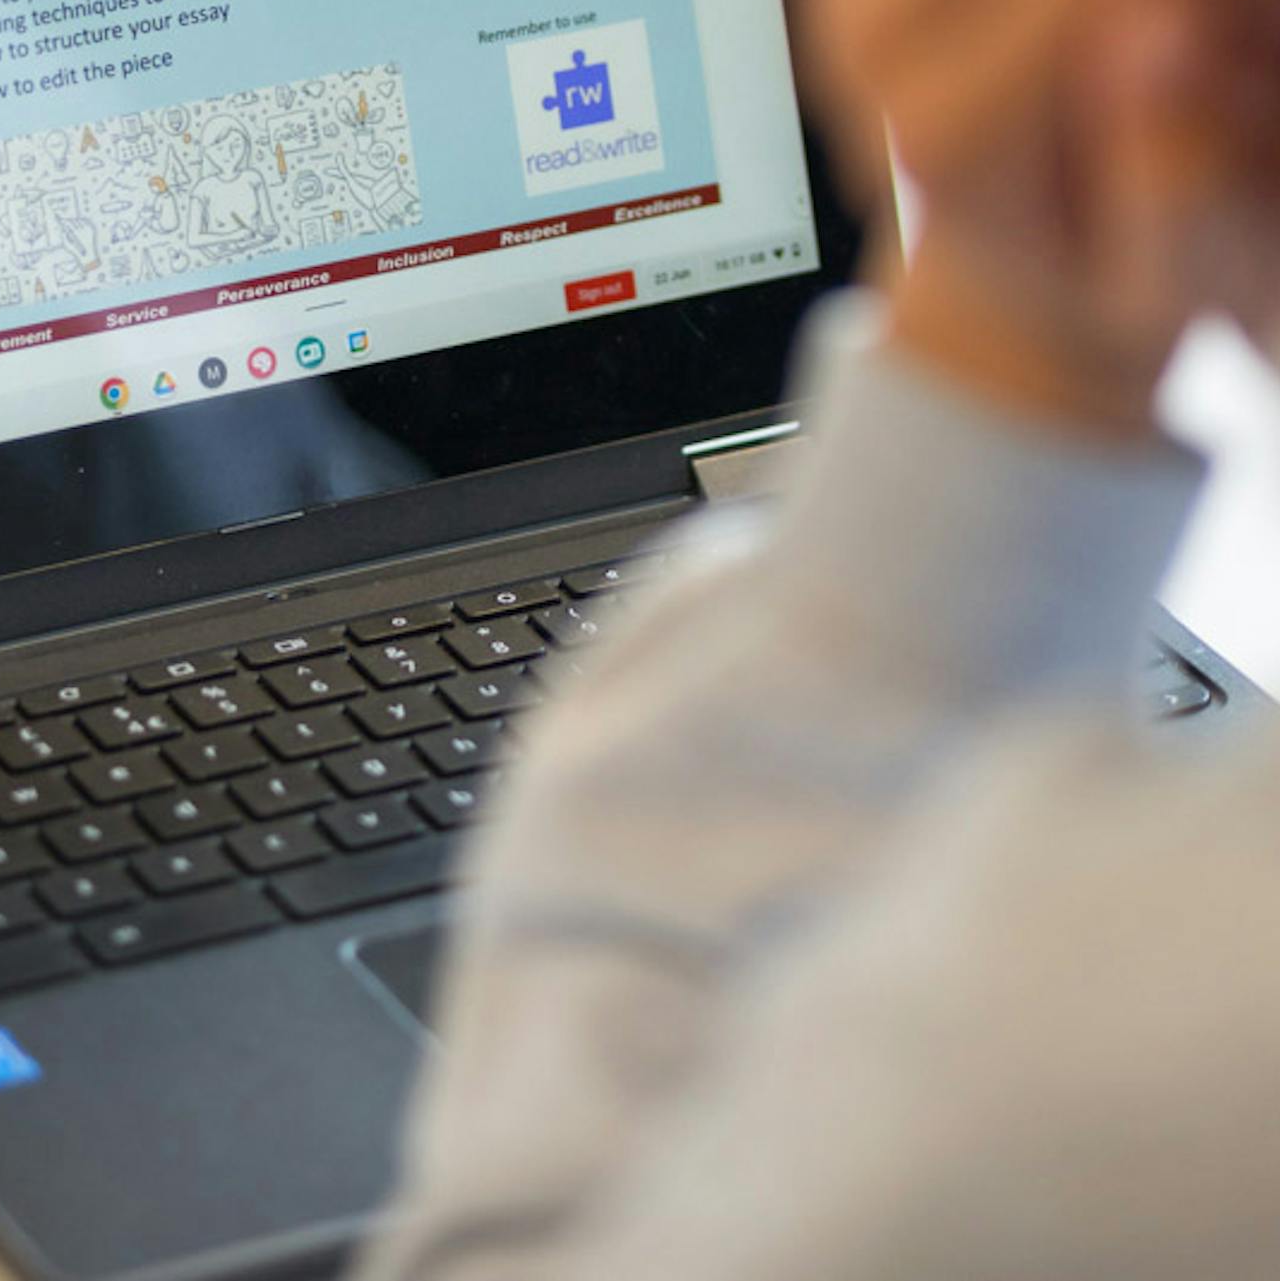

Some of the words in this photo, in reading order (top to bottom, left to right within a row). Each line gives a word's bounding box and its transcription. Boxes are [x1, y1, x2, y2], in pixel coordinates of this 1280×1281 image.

[8, 38, 30, 61] to
[33, 21, 125, 56] structure
[128, 14, 174, 40] your
[177, 1, 231, 28] essay
[477, 18, 553, 45] Remember
[555, 16, 571, 29] to
[573, 10, 598, 26] use
[13, 74, 35, 96] to
[38, 65, 80, 92] edit
[82, 58, 117, 81] the
[120, 48, 175, 79] piece
[564, 81, 603, 110] rw
[525, 127, 658, 176] read&write
[106, 301, 170, 329] Service
[216, 267, 331, 306] Perseverance
[376, 242, 455, 273] Inclusion
[499, 220, 569, 247] Respect
[613, 192, 703, 224] Excellence
